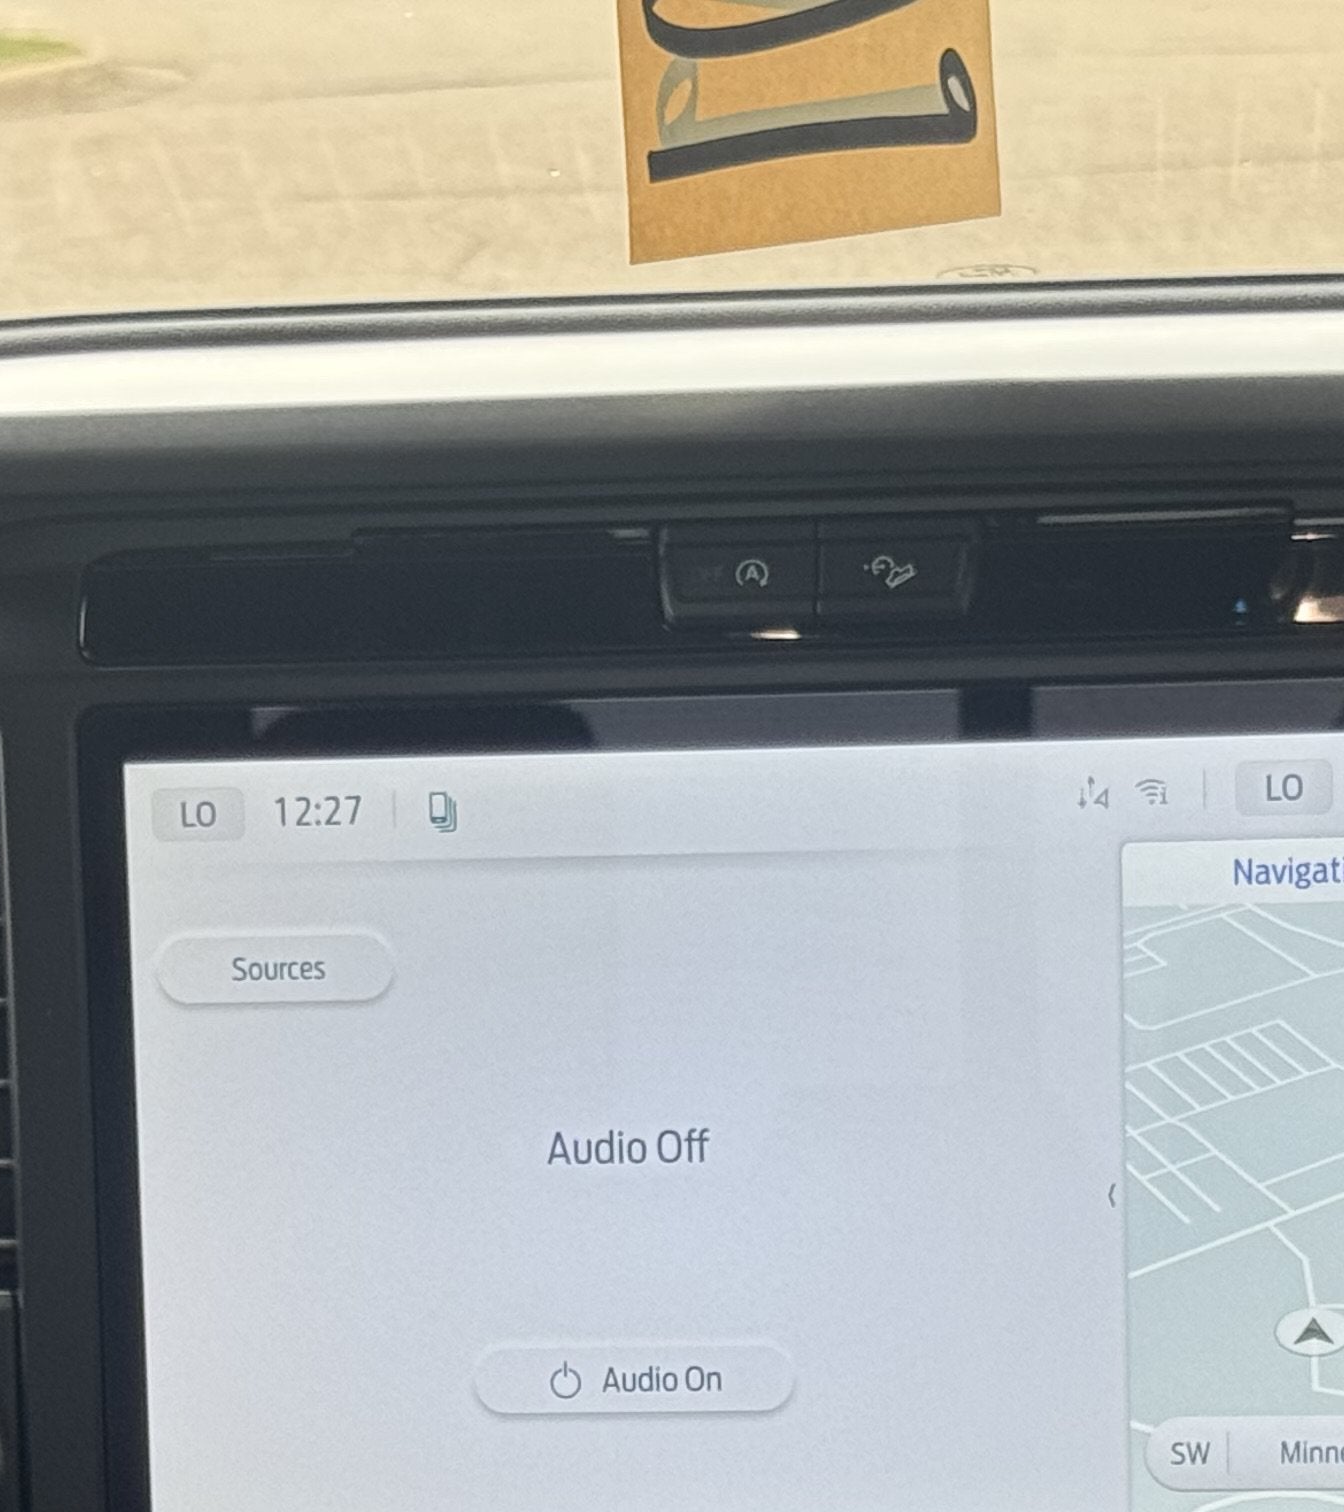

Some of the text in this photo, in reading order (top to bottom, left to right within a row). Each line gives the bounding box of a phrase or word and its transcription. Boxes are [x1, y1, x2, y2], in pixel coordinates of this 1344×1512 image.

[1265, 774, 1304, 802] LO
[180, 800, 217, 828] LO
[274, 795, 363, 828] 12:27
[231, 956, 326, 983] Sources
[547, 1127, 711, 1165] Audio Off
[603, 1364, 723, 1393] Audio On
[1170, 1442, 1211, 1466] SW
